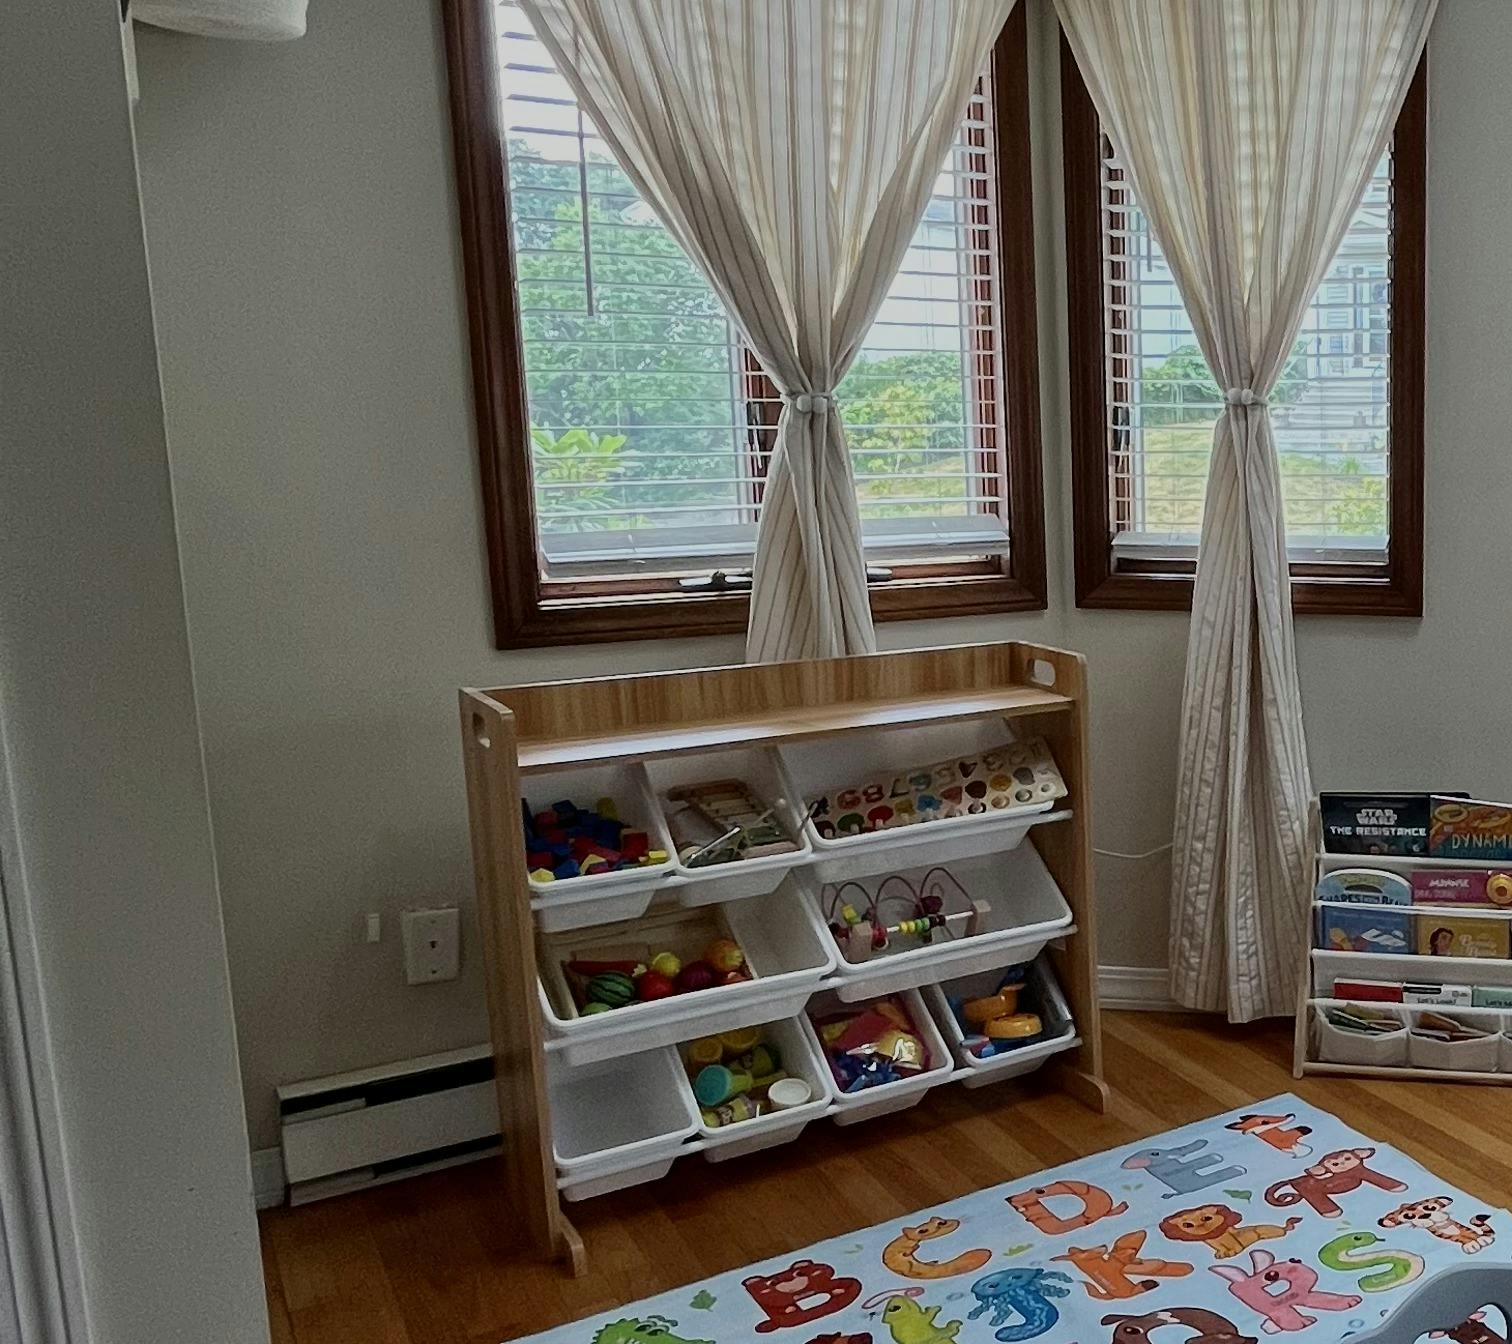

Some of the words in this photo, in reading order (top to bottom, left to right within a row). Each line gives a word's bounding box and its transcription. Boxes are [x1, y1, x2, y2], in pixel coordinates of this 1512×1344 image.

[1330, 826, 1352, 835] THE
[1355, 826, 1427, 836] RESISTANCE
[1356, 813, 1398, 825] WARS
[1360, 808, 1394, 816] STAR
[741, 1259, 862, 1333] B
[882, 1217, 993, 1279] C
[1006, 1181, 1129, 1235] D
[1050, 1230, 1194, 1300] K
[1208, 1250, 1363, 1334] R
[1318, 1232, 1425, 1292] S
